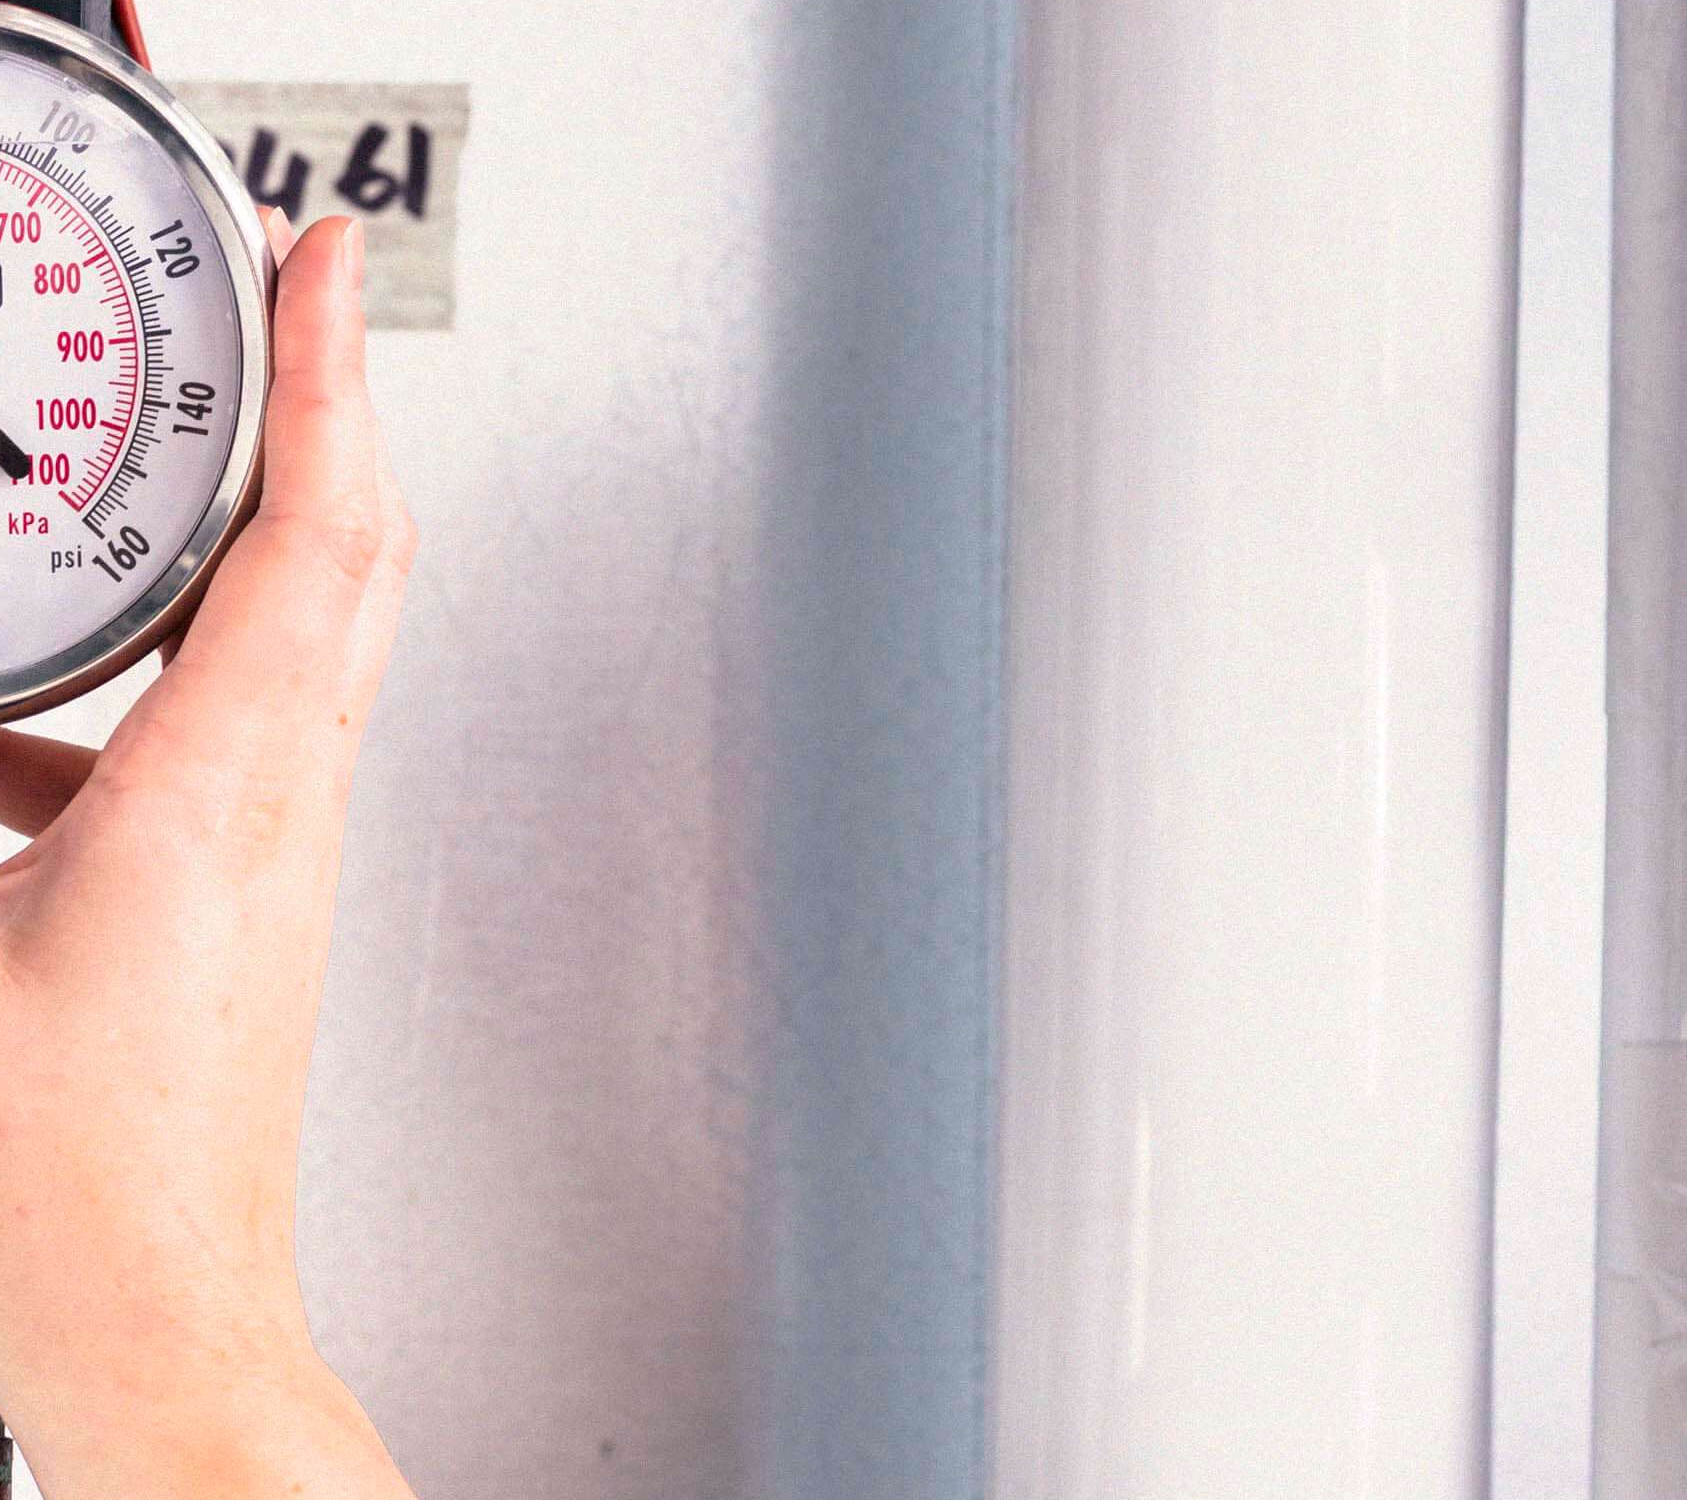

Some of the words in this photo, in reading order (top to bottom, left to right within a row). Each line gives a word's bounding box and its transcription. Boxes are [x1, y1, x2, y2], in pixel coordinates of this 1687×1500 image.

[37, 100, 96, 152] 100
[150, 219, 202, 279] 120
[34, 264, 80, 295] 800
[56, 330, 104, 363] 900
[35, 398, 96, 430] 1000
[172, 379, 217, 437] 140
[8, 453, 70, 486] 100
[8, 511, 49, 537] kPa
[50, 544, 83, 572] psi
[92, 527, 152, 584] 160
